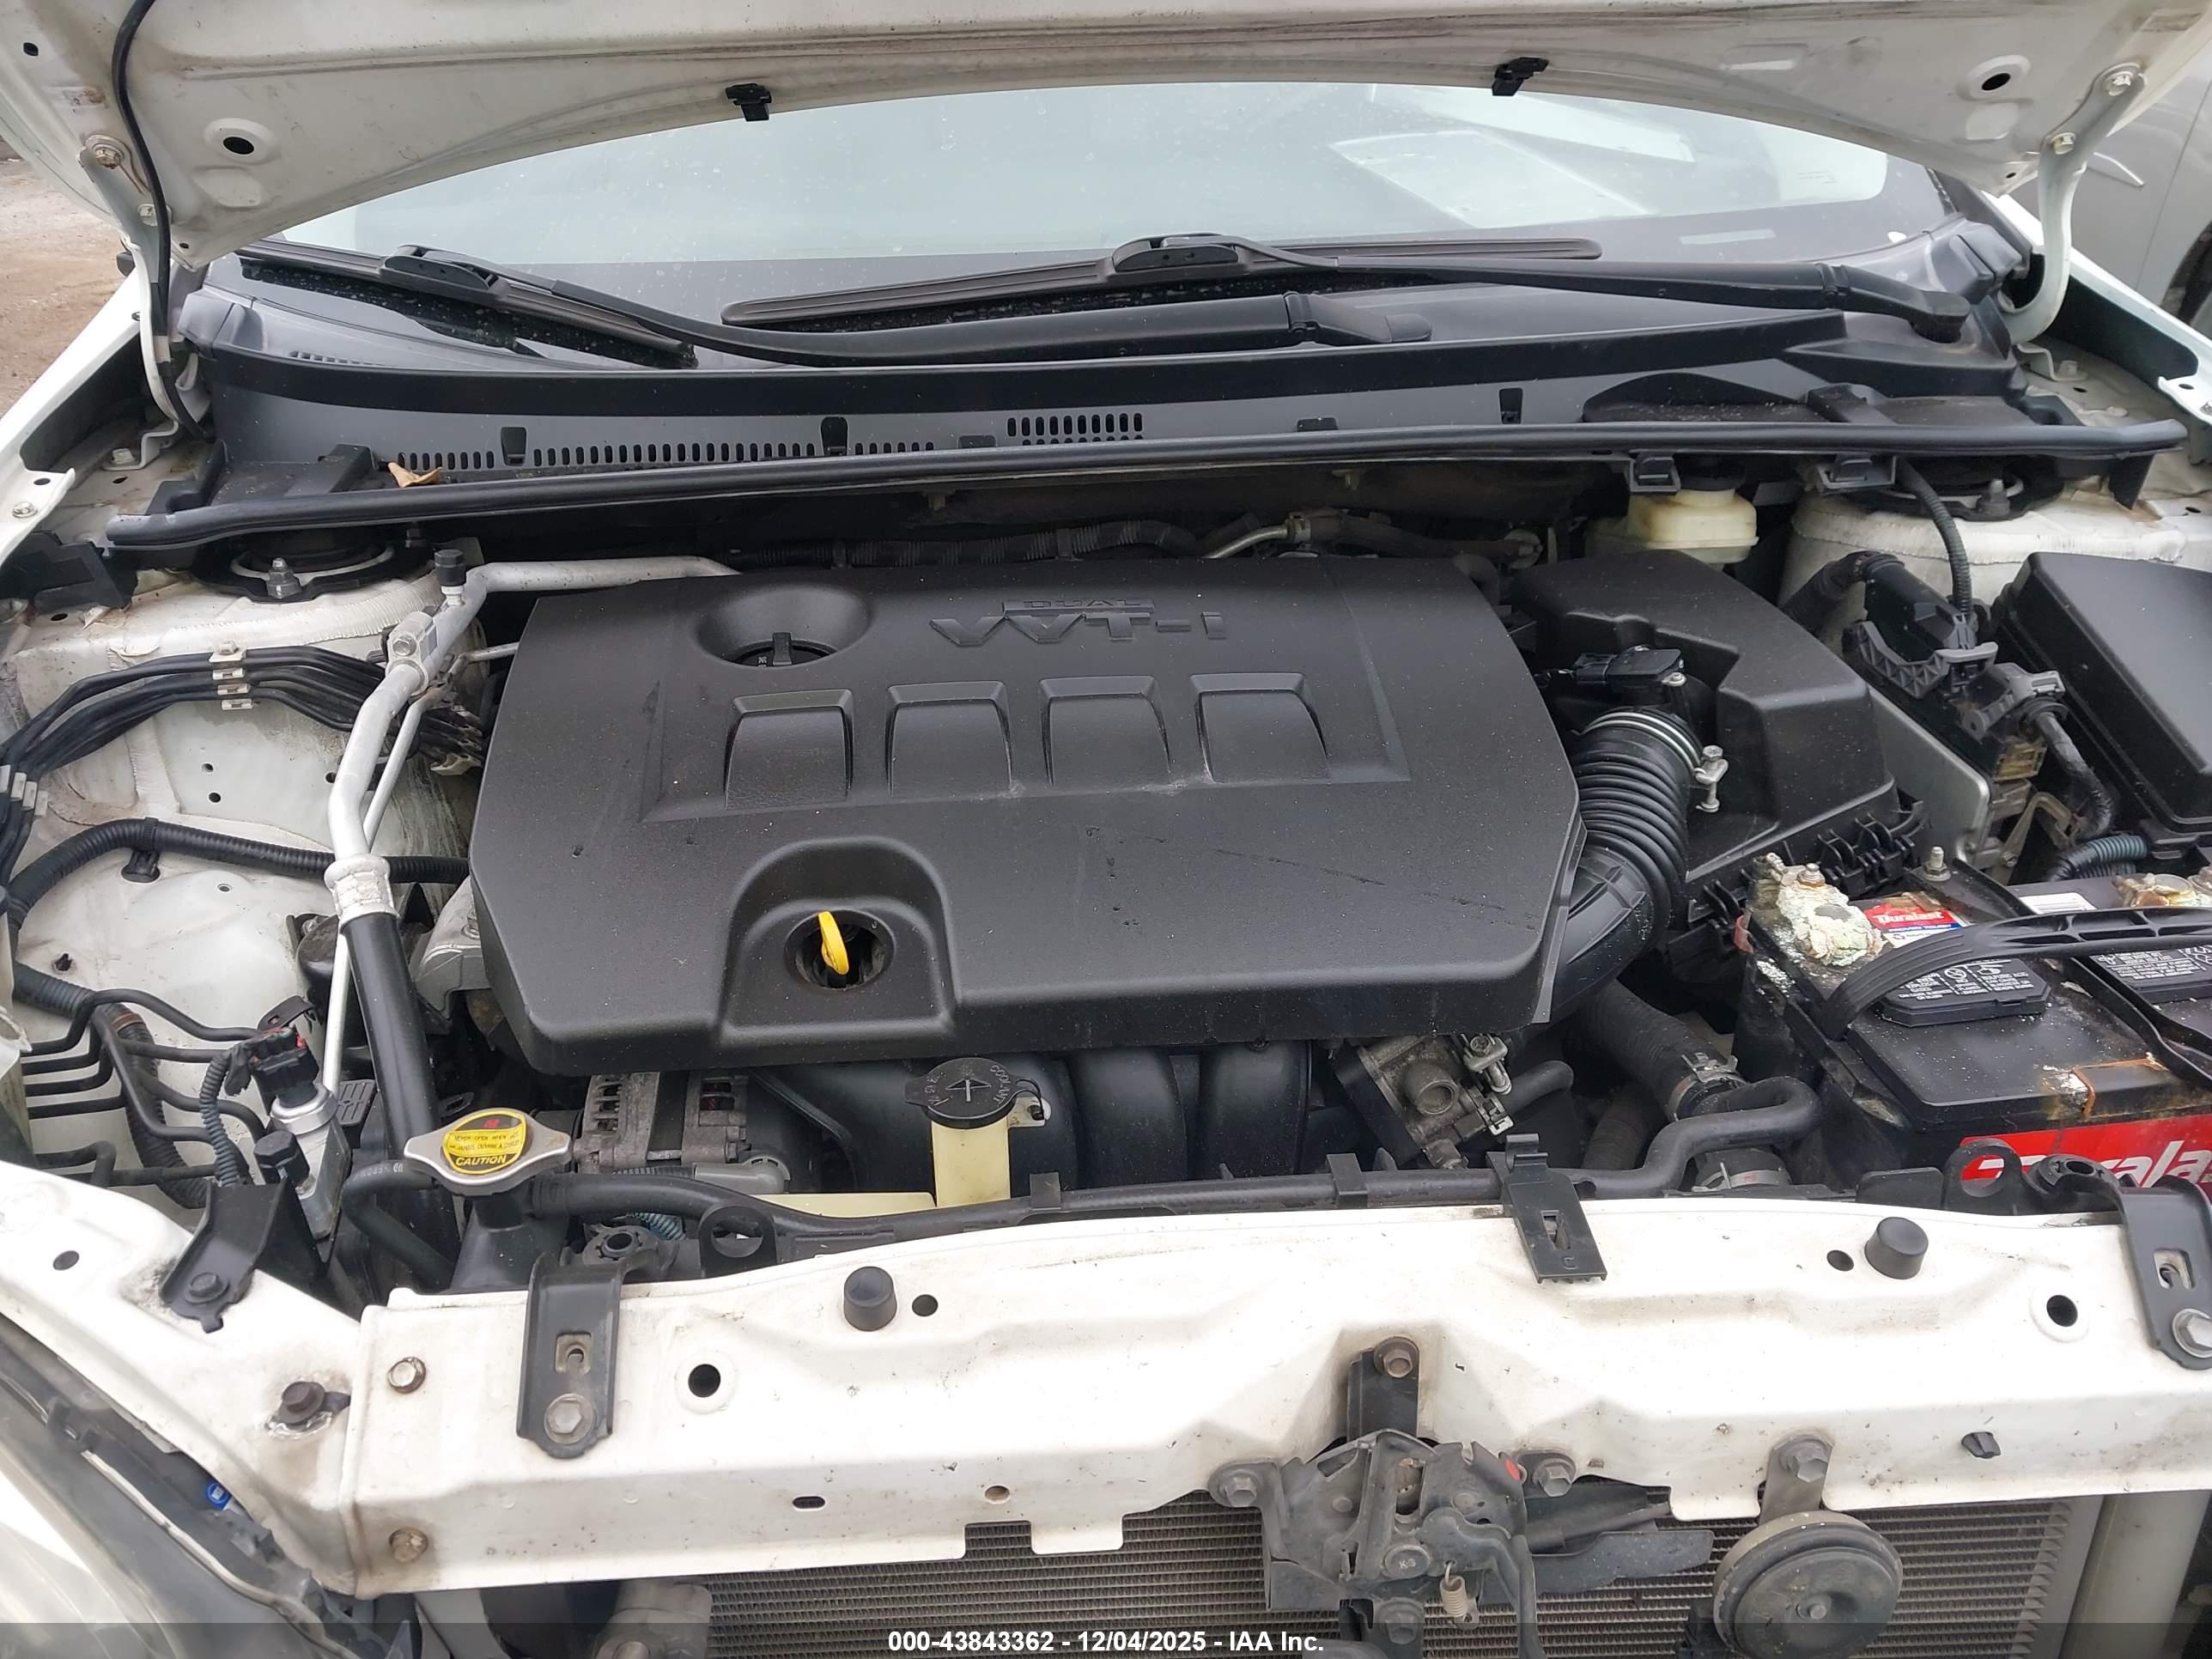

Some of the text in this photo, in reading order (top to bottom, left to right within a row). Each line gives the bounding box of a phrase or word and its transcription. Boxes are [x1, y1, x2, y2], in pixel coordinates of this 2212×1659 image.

[1023, 599, 1143, 608] DUAL
[1872, 912, 1945, 923] Duralast
[990, 1064, 1012, 1108] COOLANT
[455, 1155, 507, 1166] CAUTION
